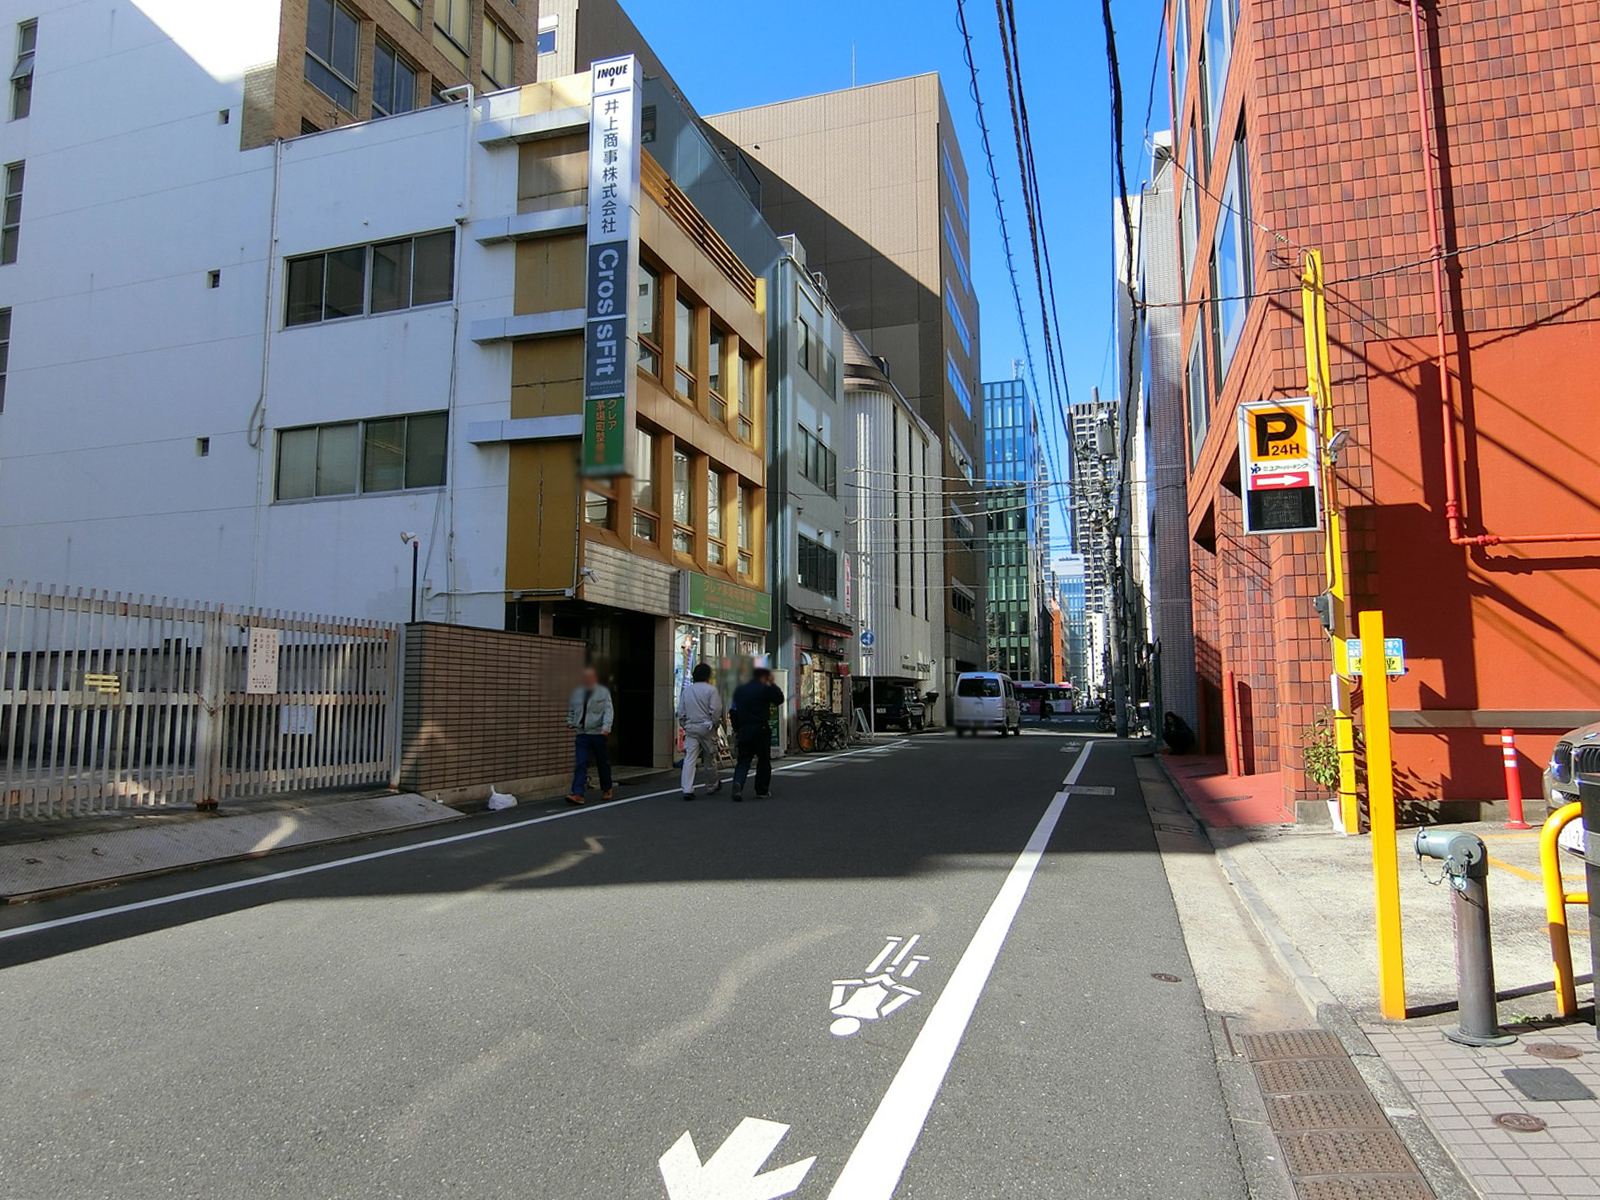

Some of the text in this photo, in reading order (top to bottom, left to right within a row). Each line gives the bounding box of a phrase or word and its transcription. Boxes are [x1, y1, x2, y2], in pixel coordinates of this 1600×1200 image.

[597, 64, 628, 79] INOUE
[609, 78, 615, 87] 1
[601, 99, 619, 234] 井上商事株式会社
[607, 399, 617, 431] クレア
[1255, 412, 1298, 457] P
[1271, 443, 1300, 456] 24H
